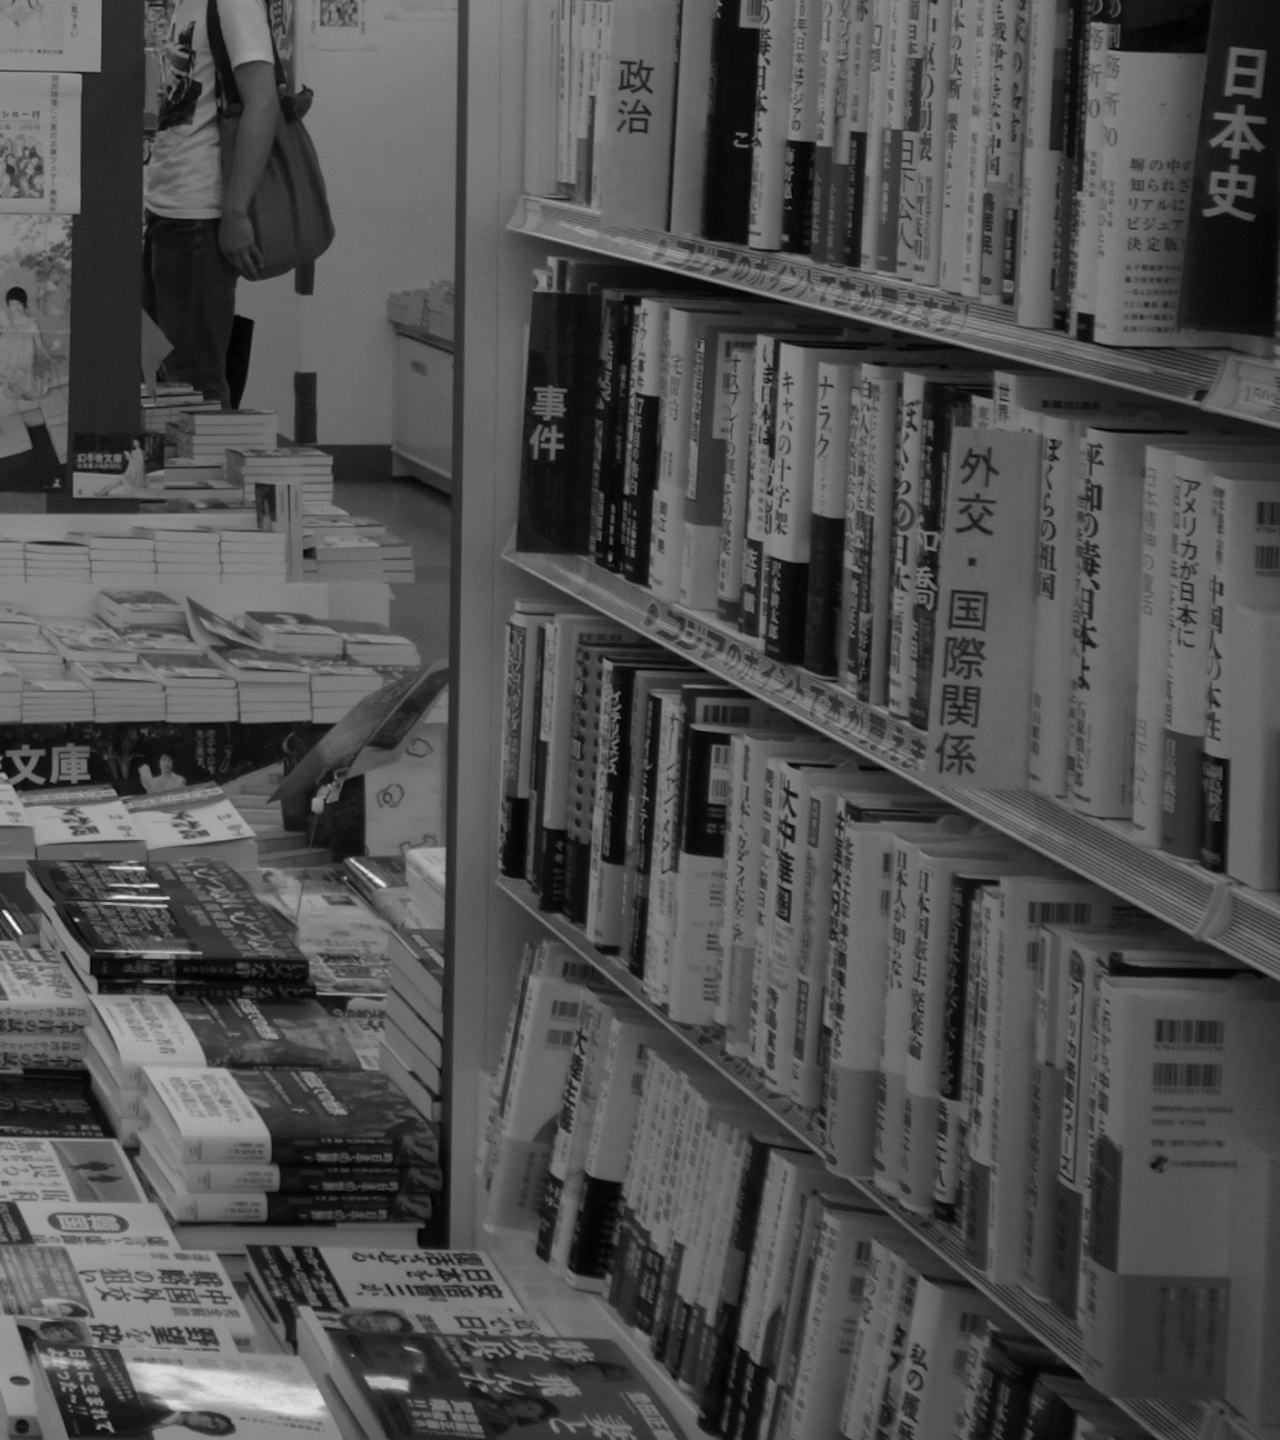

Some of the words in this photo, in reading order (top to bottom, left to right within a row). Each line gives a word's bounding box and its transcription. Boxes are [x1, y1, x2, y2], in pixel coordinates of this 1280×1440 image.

[615, 57, 656, 137] 政治
[1202, 45, 1270, 223] 日本史
[1126, 216, 1185, 232] ビジュア
[1127, 197, 1186, 212] リアルに
[528, 384, 568, 462] 事件
[773, 373, 796, 536] キャパの十字架
[816, 374, 835, 459] ナラク
[1038, 437, 1063, 601] ぼくらの祖国
[1077, 442, 1105, 691] 平和の毒、日本よ
[1175, 478, 1202, 650] アメリカが日本に
[933, 445, 1000, 777] 外交・国際関係
[78, 1268, 229, 1287] 戦略の狙い
[98, 1285, 234, 1307] 中国外交
